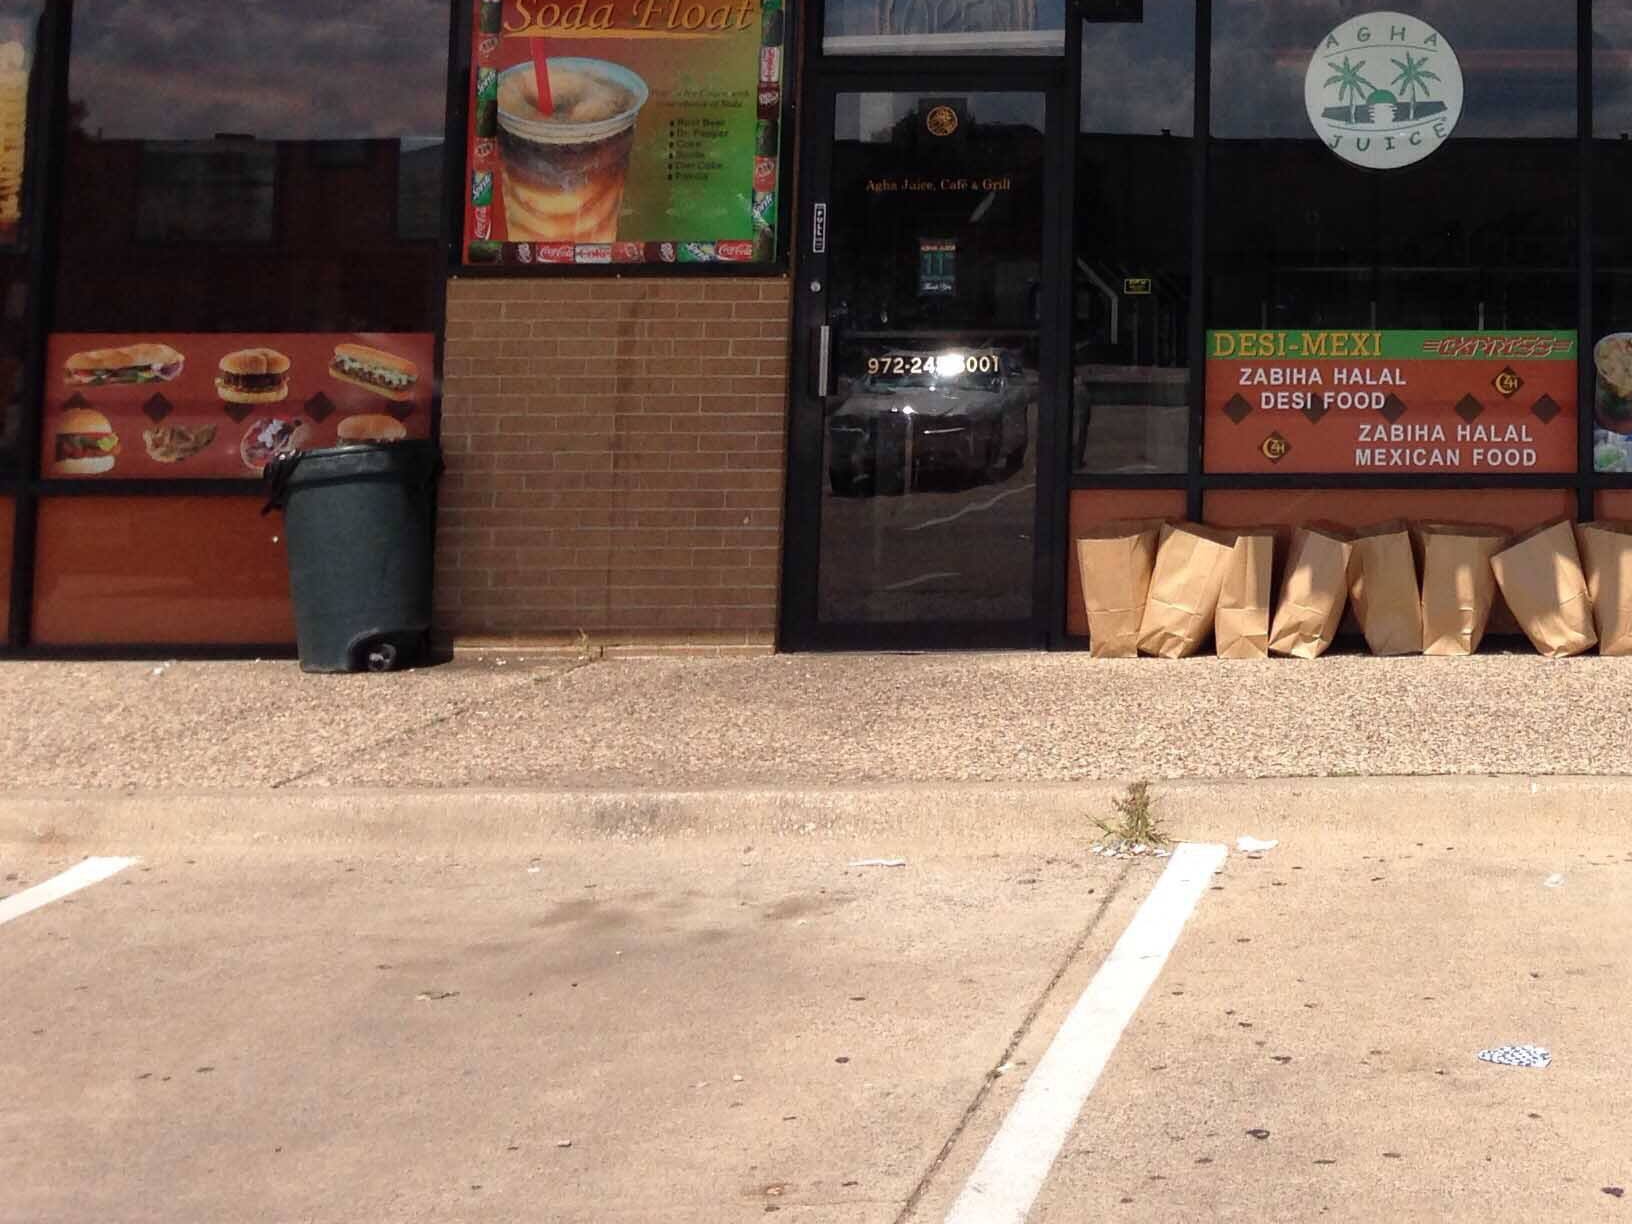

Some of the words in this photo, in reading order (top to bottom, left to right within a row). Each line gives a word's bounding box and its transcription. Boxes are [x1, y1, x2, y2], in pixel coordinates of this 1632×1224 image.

[1325, 26, 1439, 49] AGHA
[1325, 120, 1447, 152] JUICE
[1213, 332, 1383, 357] DESI-MEXI
[1239, 368, 1323, 385] ZABIHA
[1333, 368, 1407, 385] HALAL
[1260, 392, 1312, 409] DESI
[1323, 392, 1386, 409] FOOD
[1358, 425, 1442, 442] ZABIHA
[1457, 425, 1534, 442] HALAL
[1355, 448, 1460, 466] MEXICAN
[1472, 448, 1537, 466] FOOD
